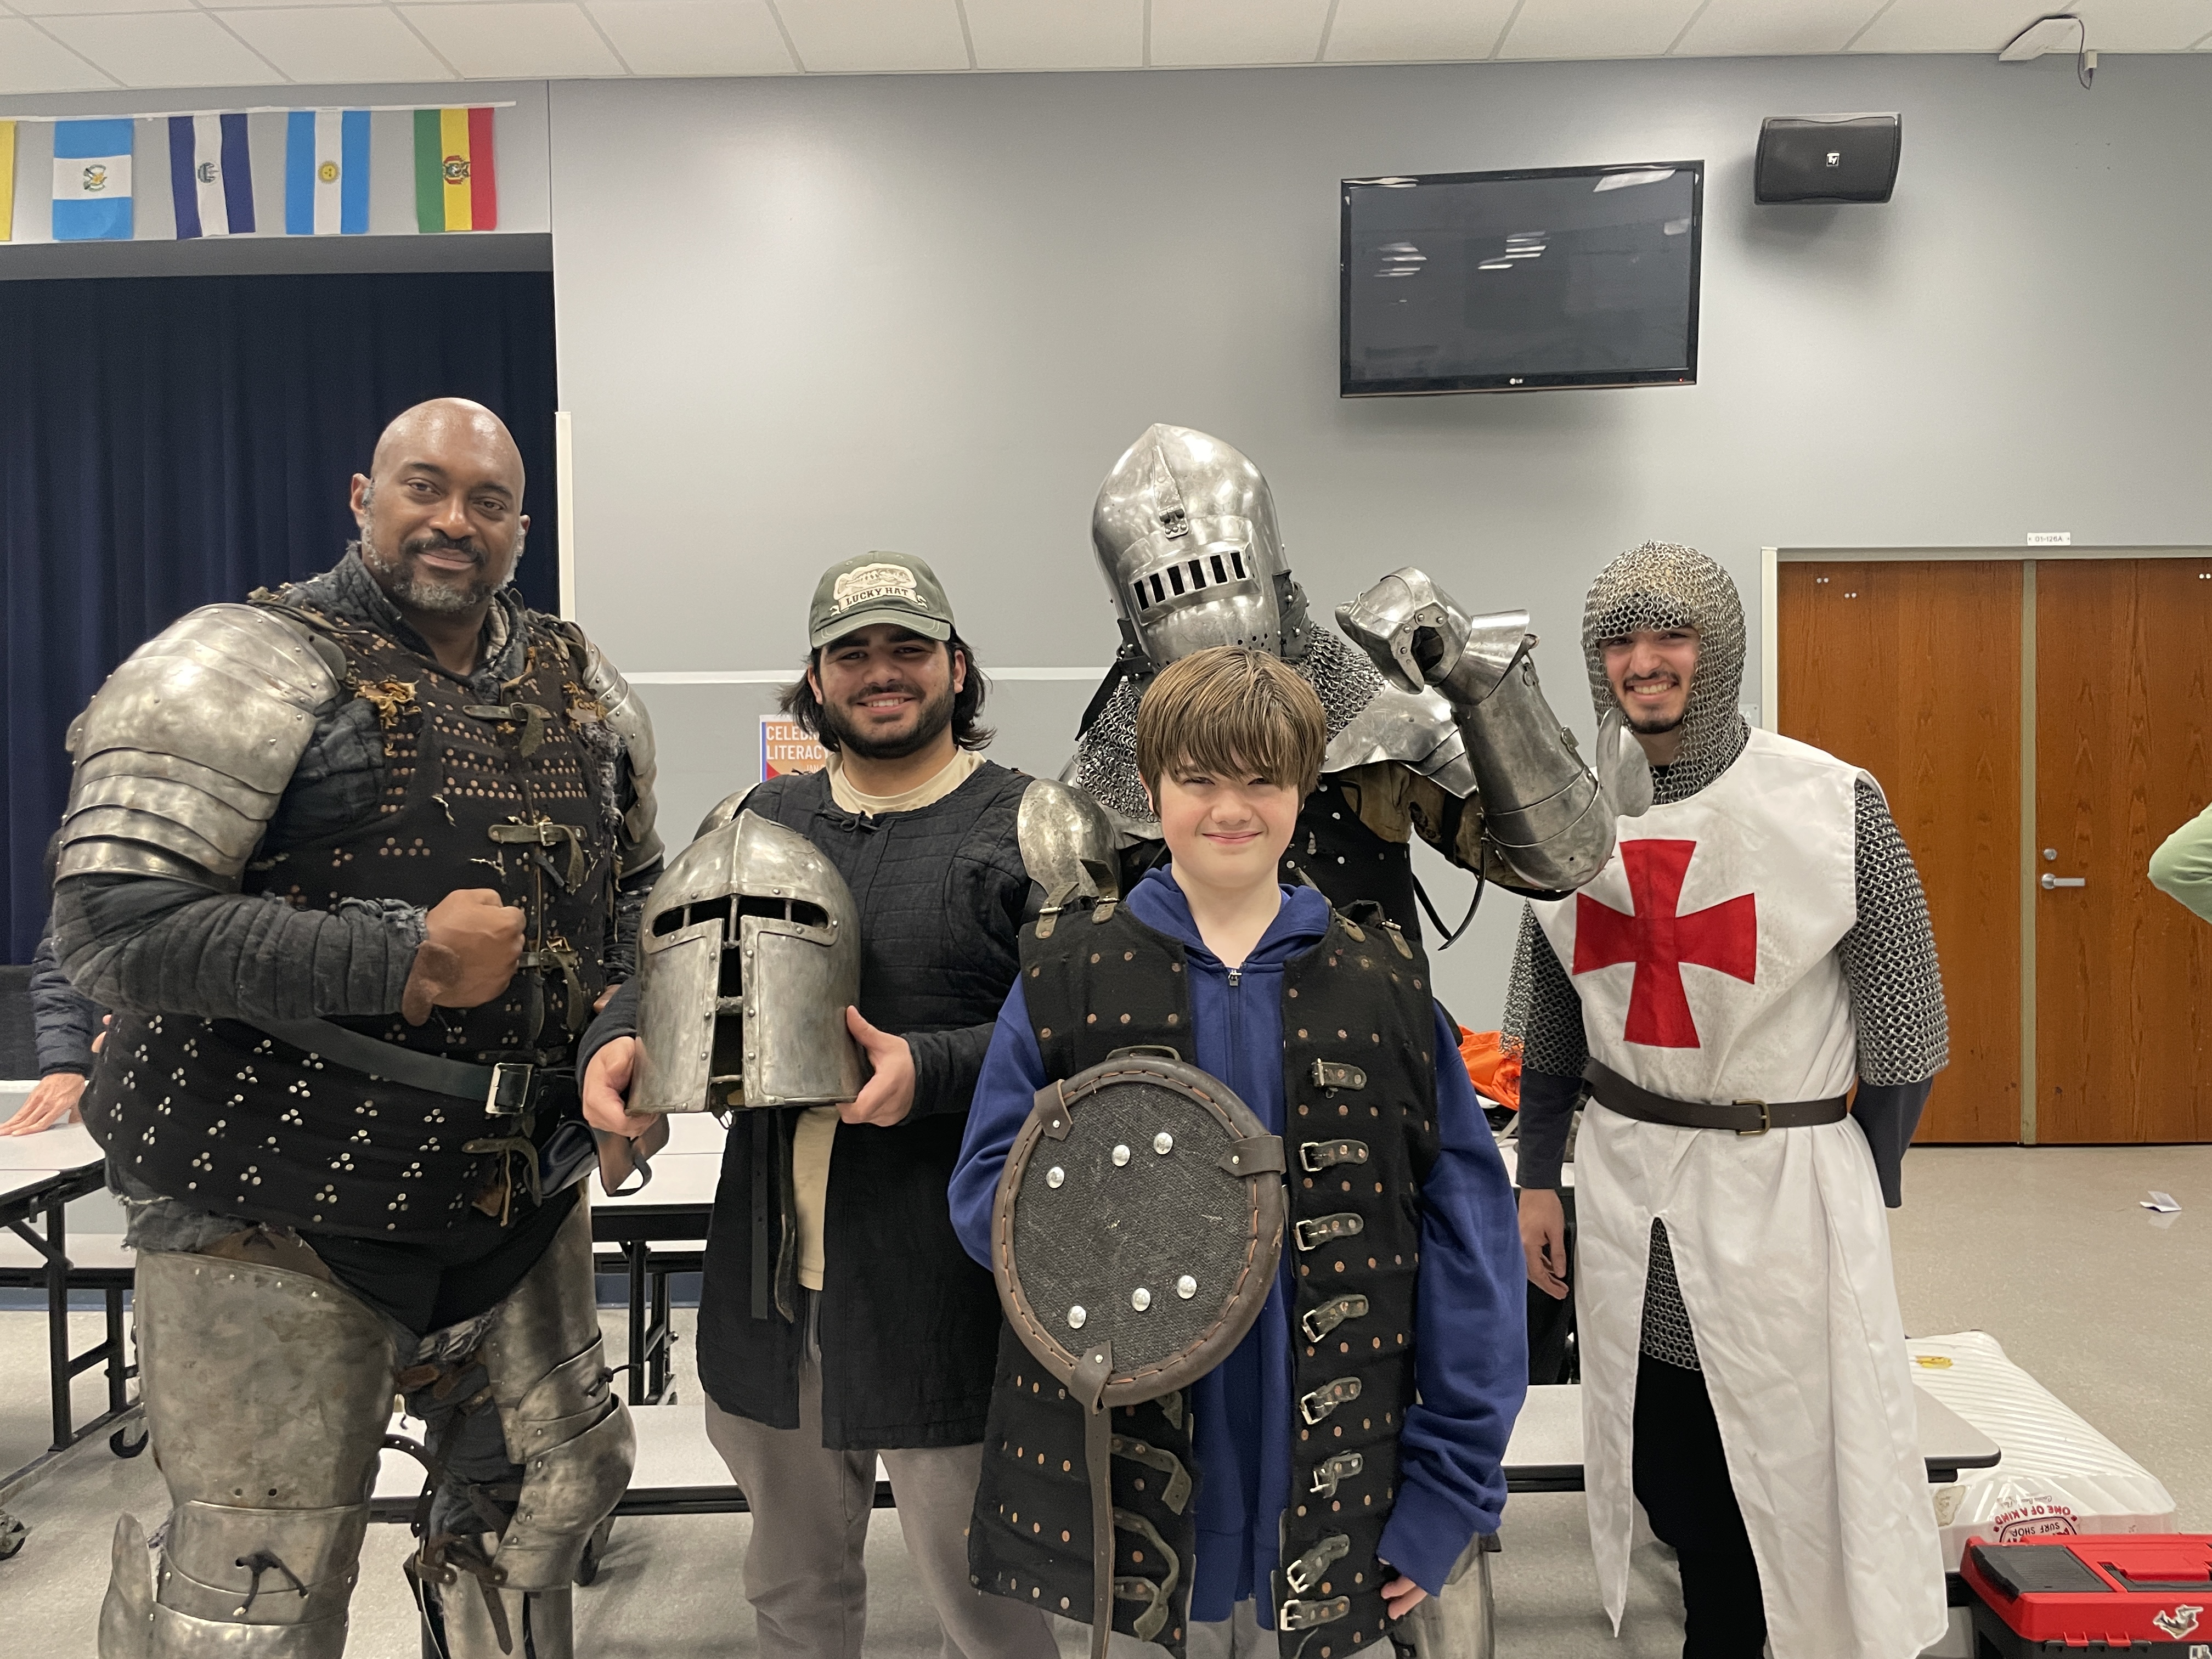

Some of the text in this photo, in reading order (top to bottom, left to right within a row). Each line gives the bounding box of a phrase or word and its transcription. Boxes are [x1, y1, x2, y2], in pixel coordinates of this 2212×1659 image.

[846, 587, 908, 606] LUCKY HAT
[1994, 1505, 2071, 1525] ONE OF A KIND
[2040, 1522, 2060, 1533] SURF
